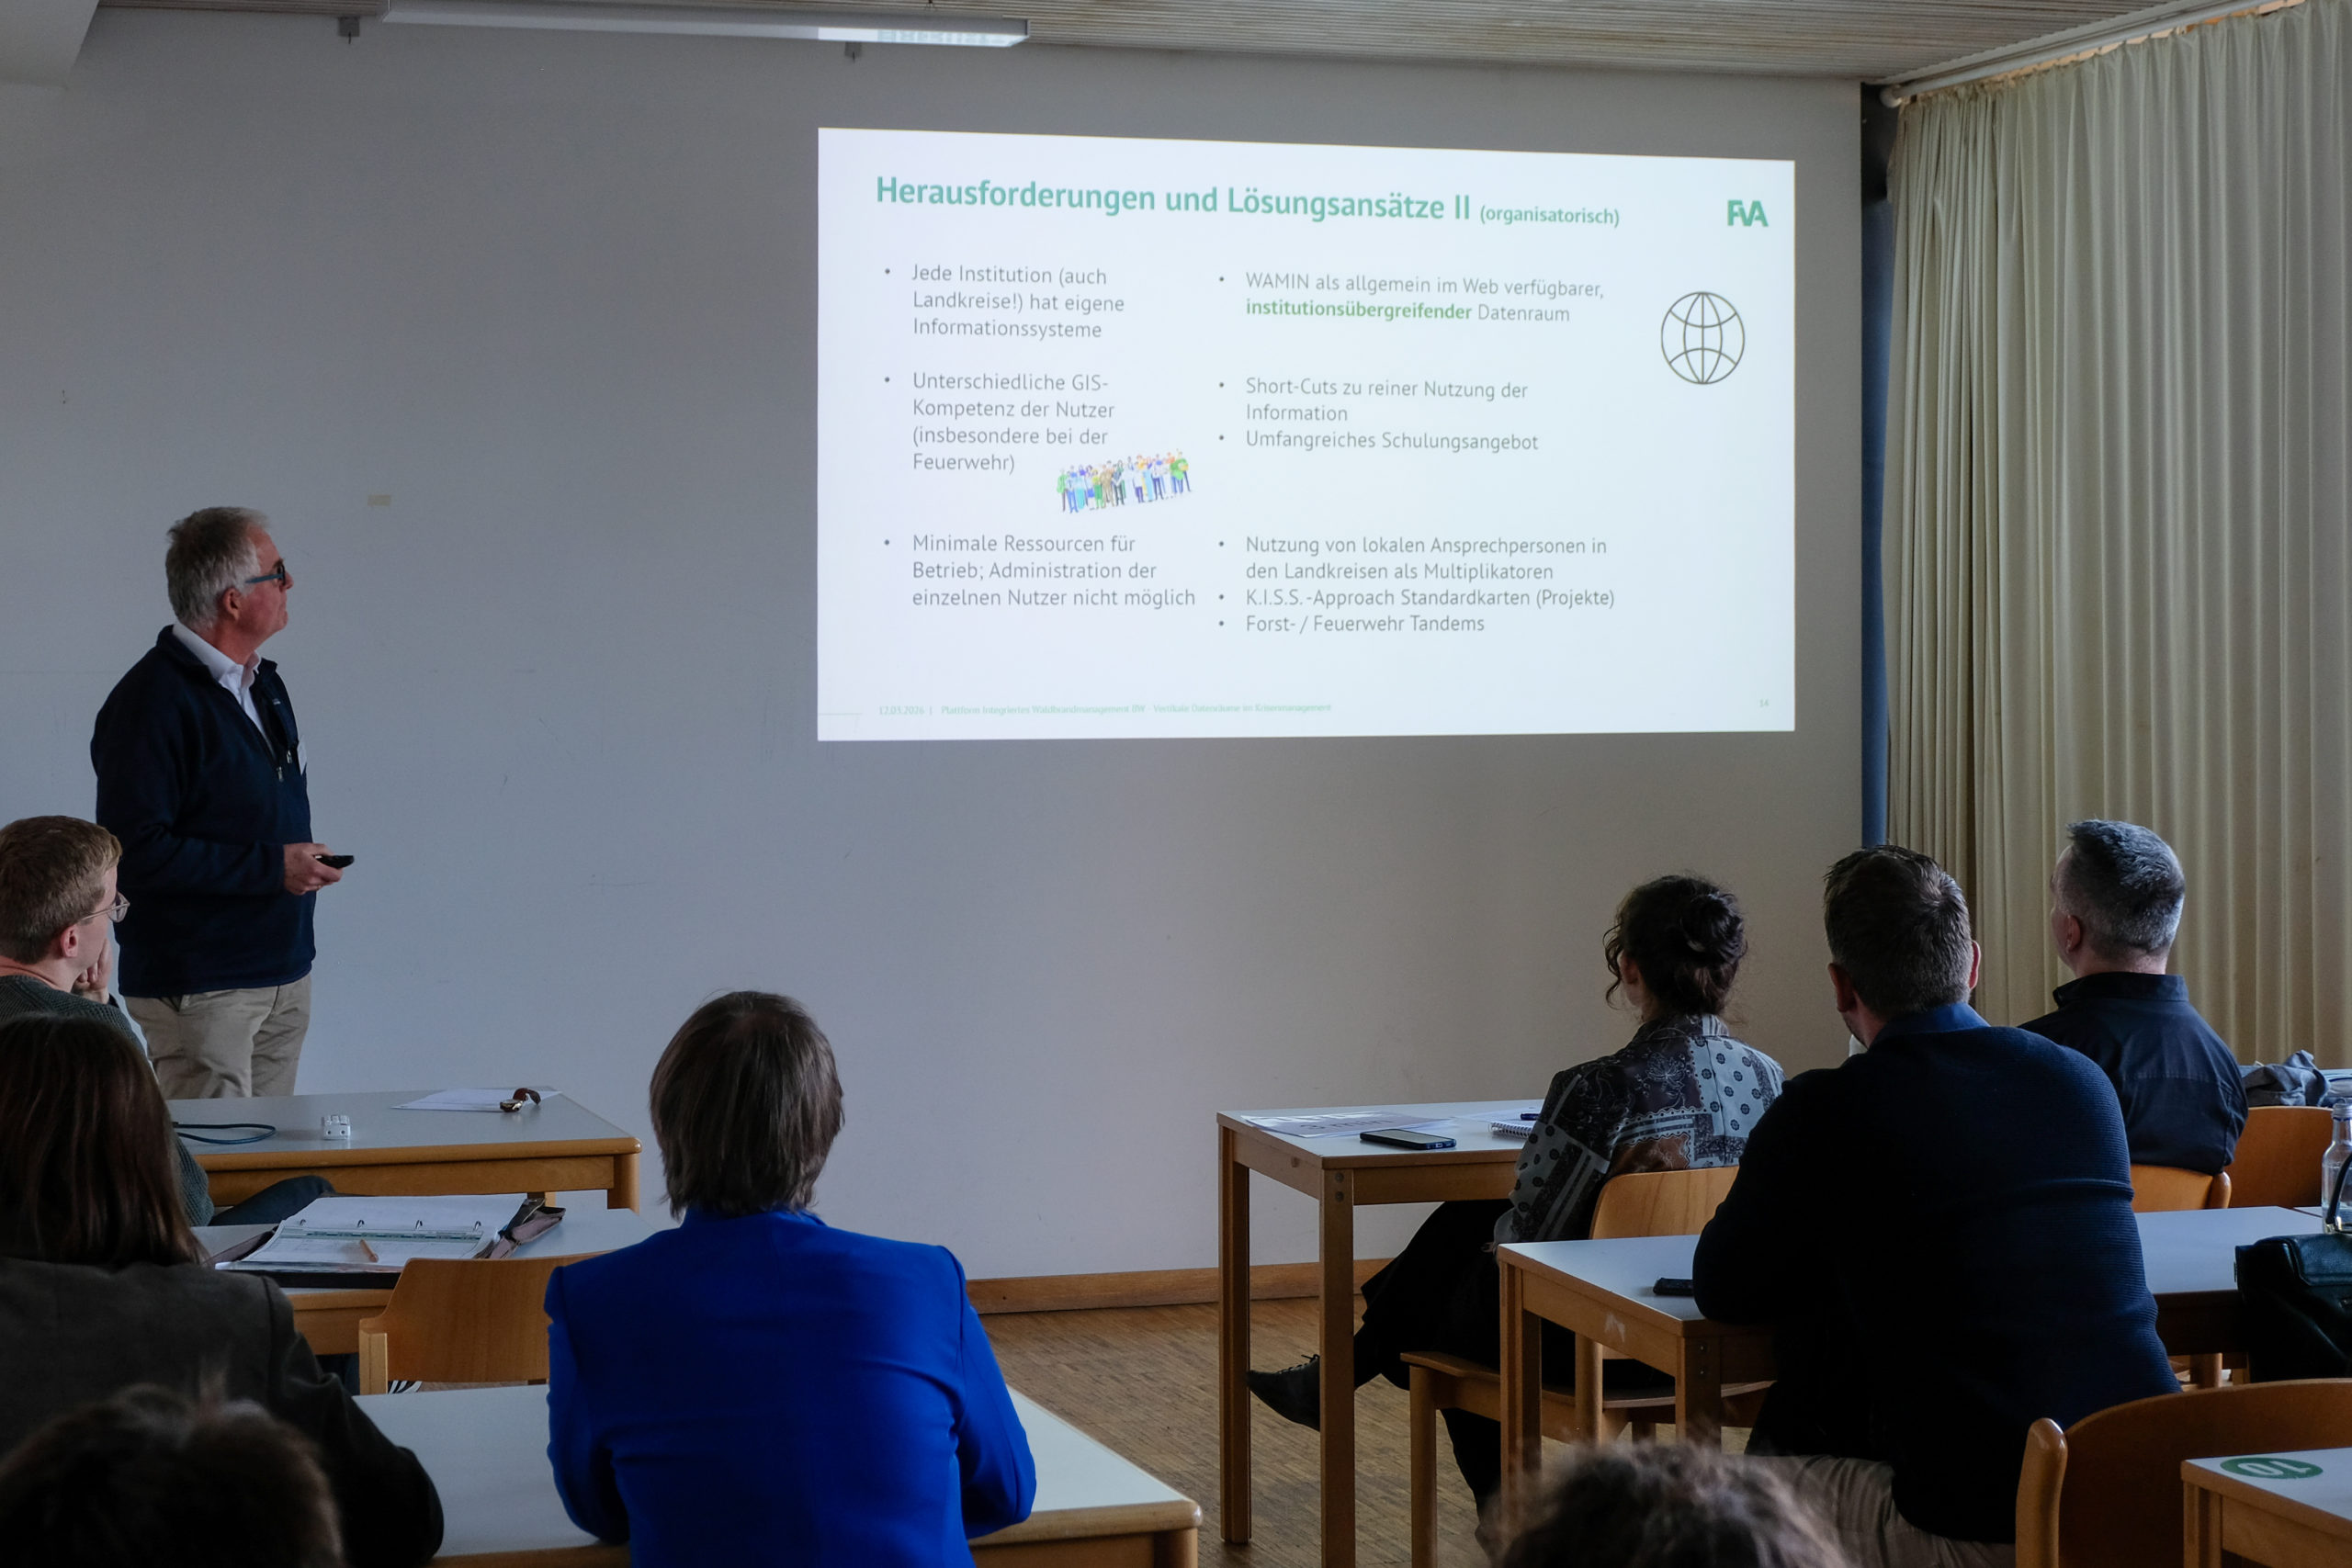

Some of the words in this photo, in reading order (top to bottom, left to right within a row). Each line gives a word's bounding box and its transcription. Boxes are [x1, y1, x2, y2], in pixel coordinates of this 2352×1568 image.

[877, 176, 1155, 216] Herausforderungen
[1166, 186, 1217, 212] und
[1228, 187, 1444, 222] Lösungsansätze
[1455, 195, 1470, 220] II
[1480, 206, 1619, 228] (organisatorisch)
[1727, 199, 1769, 227] FVA
[911, 265, 952, 281] Jede
[960, 265, 1052, 283] Institution
[1059, 268, 1106, 288] (auch
[1246, 272, 1308, 289] WAMIN
[1316, 275, 1340, 290] als
[1346, 275, 1430, 296] allgemein
[1438, 277, 1457, 293] im
[1463, 277, 1498, 294] Web
[1504, 279, 1603, 299] verfügbarer,
[914, 290, 1023, 314] Landkreise!)
[1030, 293, 1058, 310] hat
[1065, 294, 1124, 315] eigene
[1247, 299, 1473, 321] institutionsübergreifender
[1478, 304, 1569, 321] Datenraum
[914, 318, 1102, 341] Informationssysteme
[913, 372, 1065, 390] Unterschiedliche
[1072, 374, 1108, 391] GIS-
[1247, 378, 1337, 395] Short-Cuts
[1343, 383, 1362, 395] zu
[1369, 379, 1418, 396] reiner
[1425, 381, 1495, 402] Nutzung
[1501, 382, 1528, 398] der
[914, 399, 1014, 421] Kompetenz
[1021, 400, 1049, 417] der
[1057, 400, 1114, 418] Nutzer
[1248, 403, 1348, 421] Information
[913, 426, 1039, 447] (insbesondere
[1046, 427, 1071, 445] bei
[1080, 428, 1108, 445] der
[1247, 430, 1375, 451] Umfangreiches
[1382, 432, 1538, 454] Schulungsangebot
[914, 453, 1014, 475] Feuerwehr)
[913, 535, 997, 551] Minimale
[1005, 535, 1103, 552] Ressourcen
[1111, 536, 1135, 551] für
[1247, 536, 1318, 557] Nutzung
[1326, 540, 1355, 552] von
[1363, 536, 1425, 553] lokalen
[1430, 537, 1585, 558] Ansprechpersonen
[1592, 537, 1606, 553] in
[913, 561, 983, 581] Betrieb;
[989, 561, 1121, 579] Administration
[1128, 562, 1157, 579] der
[1247, 562, 1278, 579] den
[1285, 562, 1387, 579] Landkreisen
[1395, 563, 1418, 579] als
[1425, 563, 1553, 583] Multiplikatoren
[913, 589, 1001, 605] einzelnen
[1009, 589, 1068, 605] Nutzer
[1074, 589, 1118, 605] nicht
[1125, 589, 1194, 610] möglich
[1401, 589, 1530, 605] Standardkarten
[1536, 589, 1614, 610] (Projekte)
[1247, 615, 1295, 631] Forst-
[1299, 615, 1308, 634] /
[1314, 615, 1405, 631] Feuerwehr
[1409, 615, 1484, 631] Tandems
[982, 705, 1030, 716] Integriertes
[1032, 704, 1130, 716] Waldbrandmanagement
[1154, 704, 1191, 714] Vertikale
[1255, 703, 1331, 715] Krisenmanagement
[2237, 1461, 2312, 1476] 10
